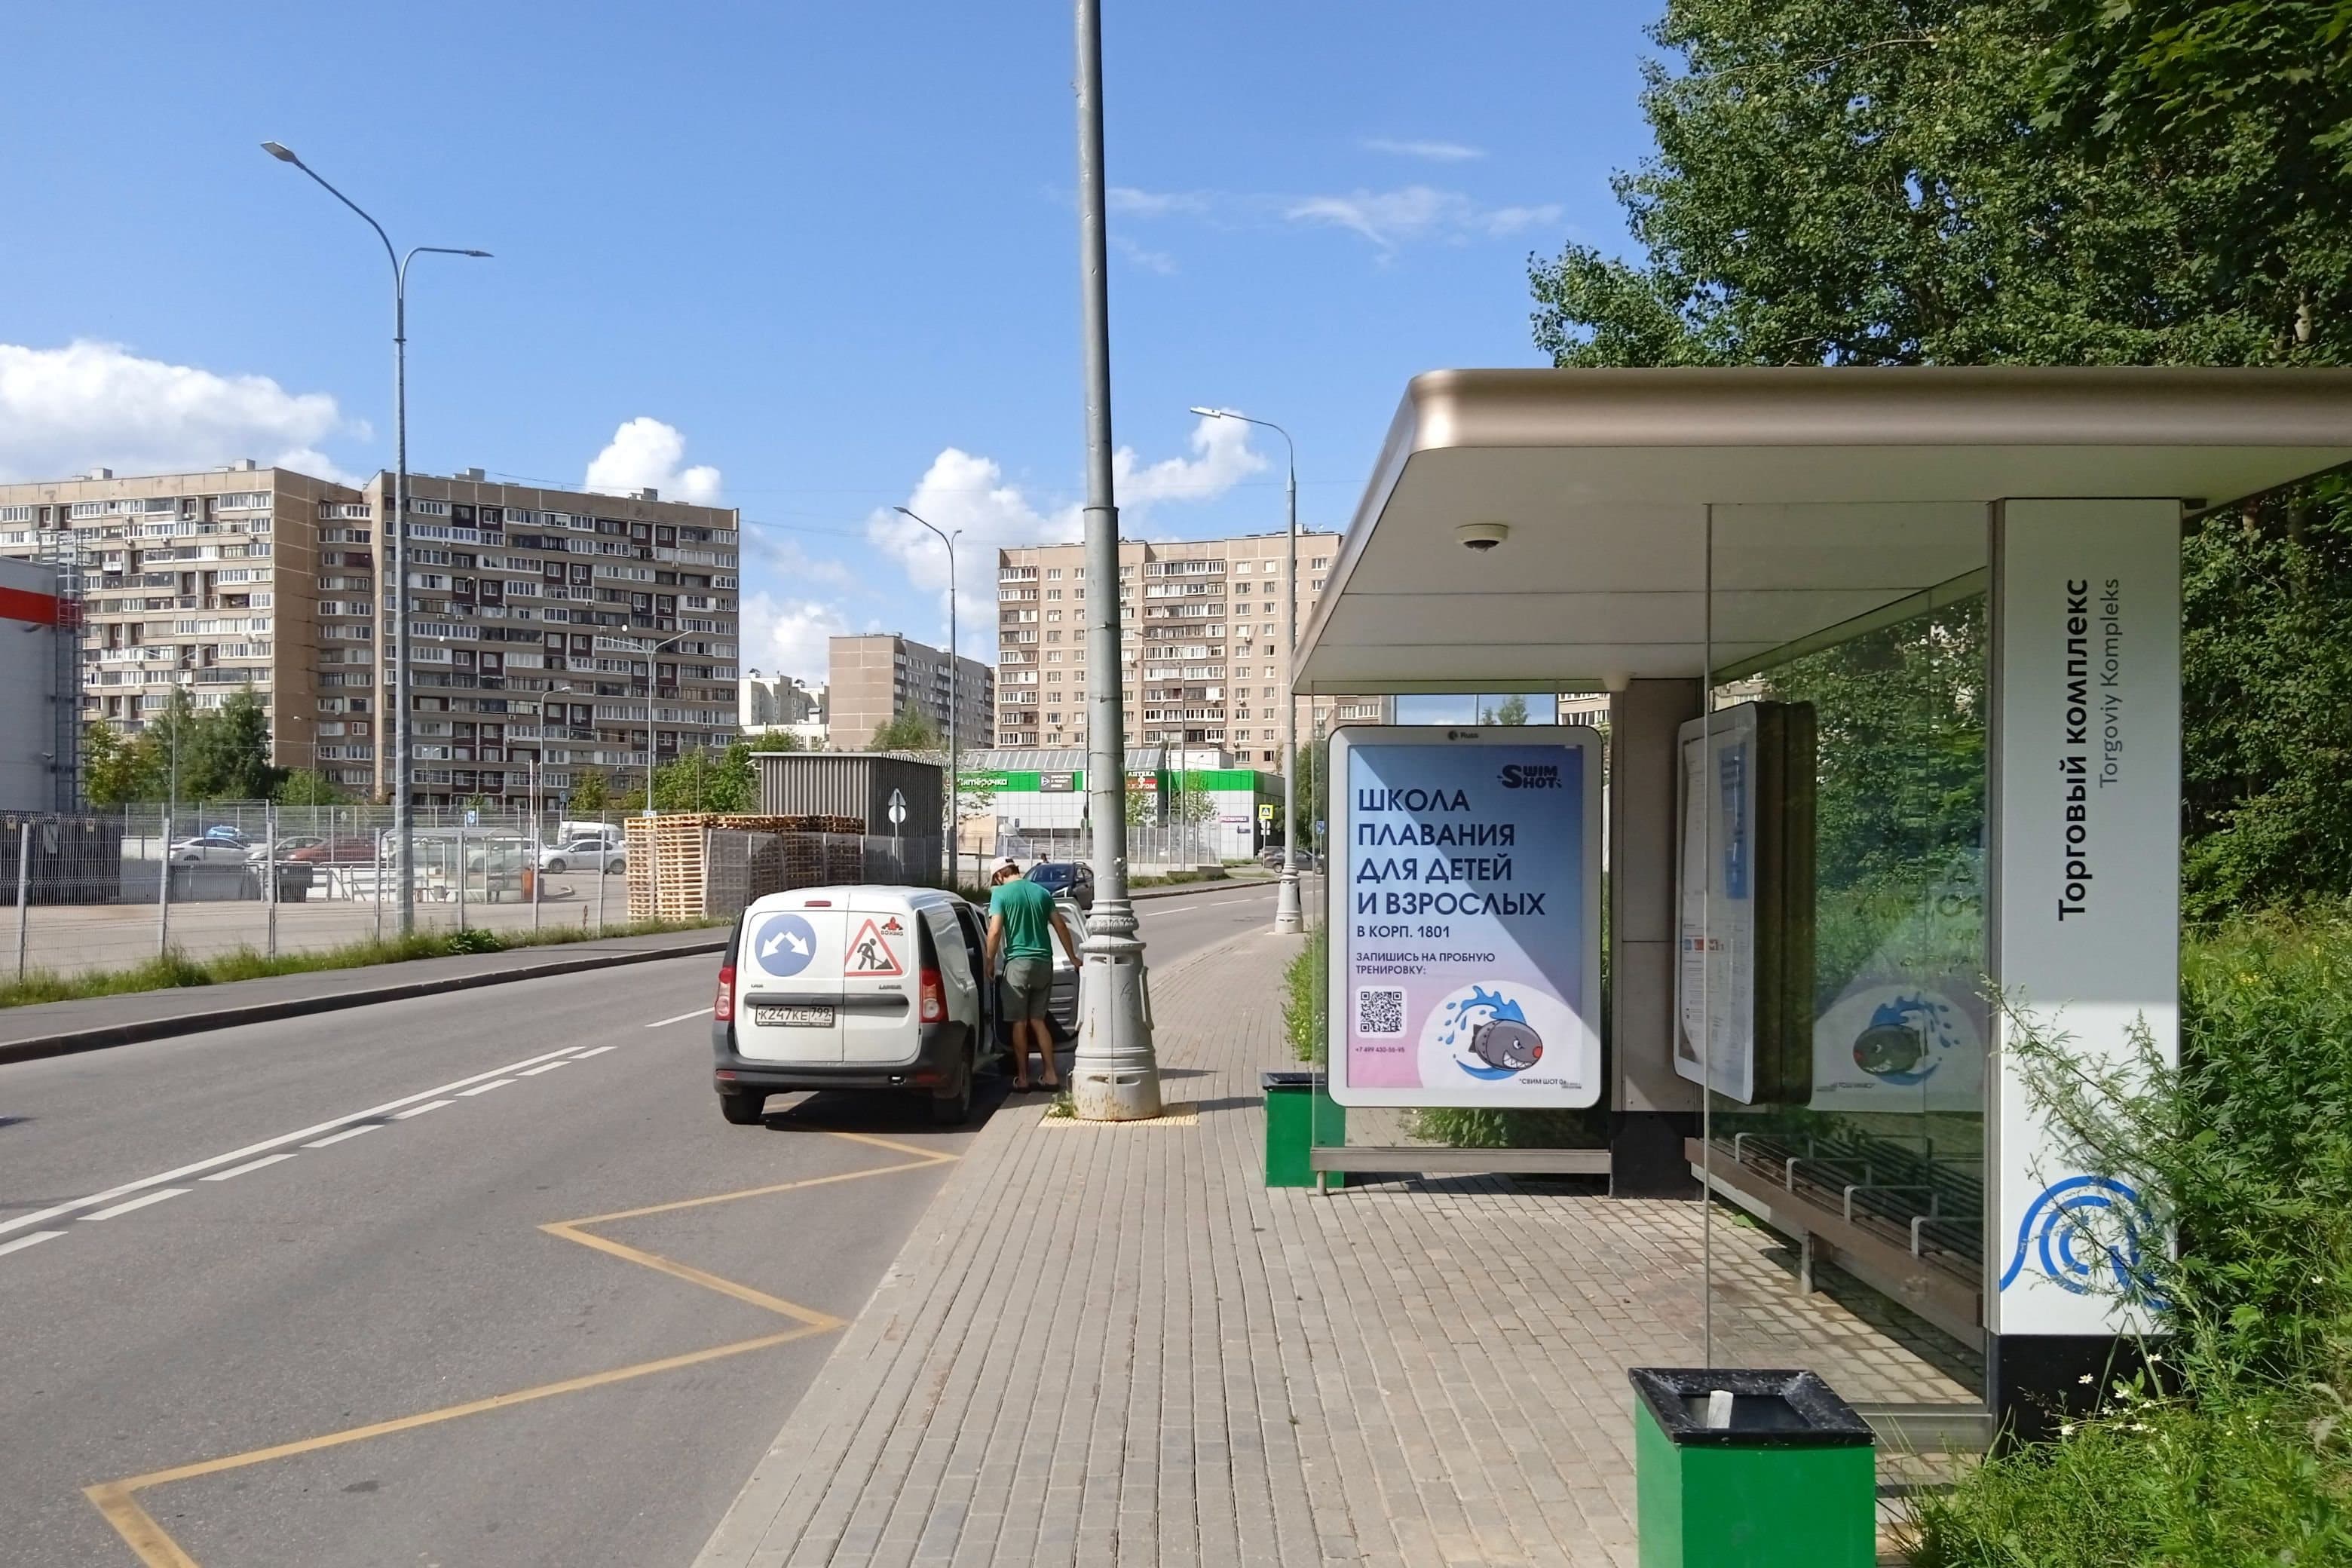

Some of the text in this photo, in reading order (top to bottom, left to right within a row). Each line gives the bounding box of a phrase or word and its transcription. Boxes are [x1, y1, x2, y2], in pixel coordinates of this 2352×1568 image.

[2099, 578, 2123, 789] Torgoviy Kompleks
[2058, 579, 2093, 921] Торговый комплекс
[1358, 789, 1470, 812] ШКОЛА
[1358, 823, 1514, 847] ПЛАВАНИЯ
[1356, 853, 1511, 884] ДЛЯ ДЕТЕЙ
[1358, 892, 1545, 916] И ВЗРОСЛЫХ
[1357, 925, 1450, 938] В КОРП. 1801
[1356, 952, 1496, 963] ЗАПИШИСЬ НА ПРОБНУЮ
[1356, 965, 1427, 975] ТРЕНИРОВКУ:
[811, 1007, 830, 1018] 799
